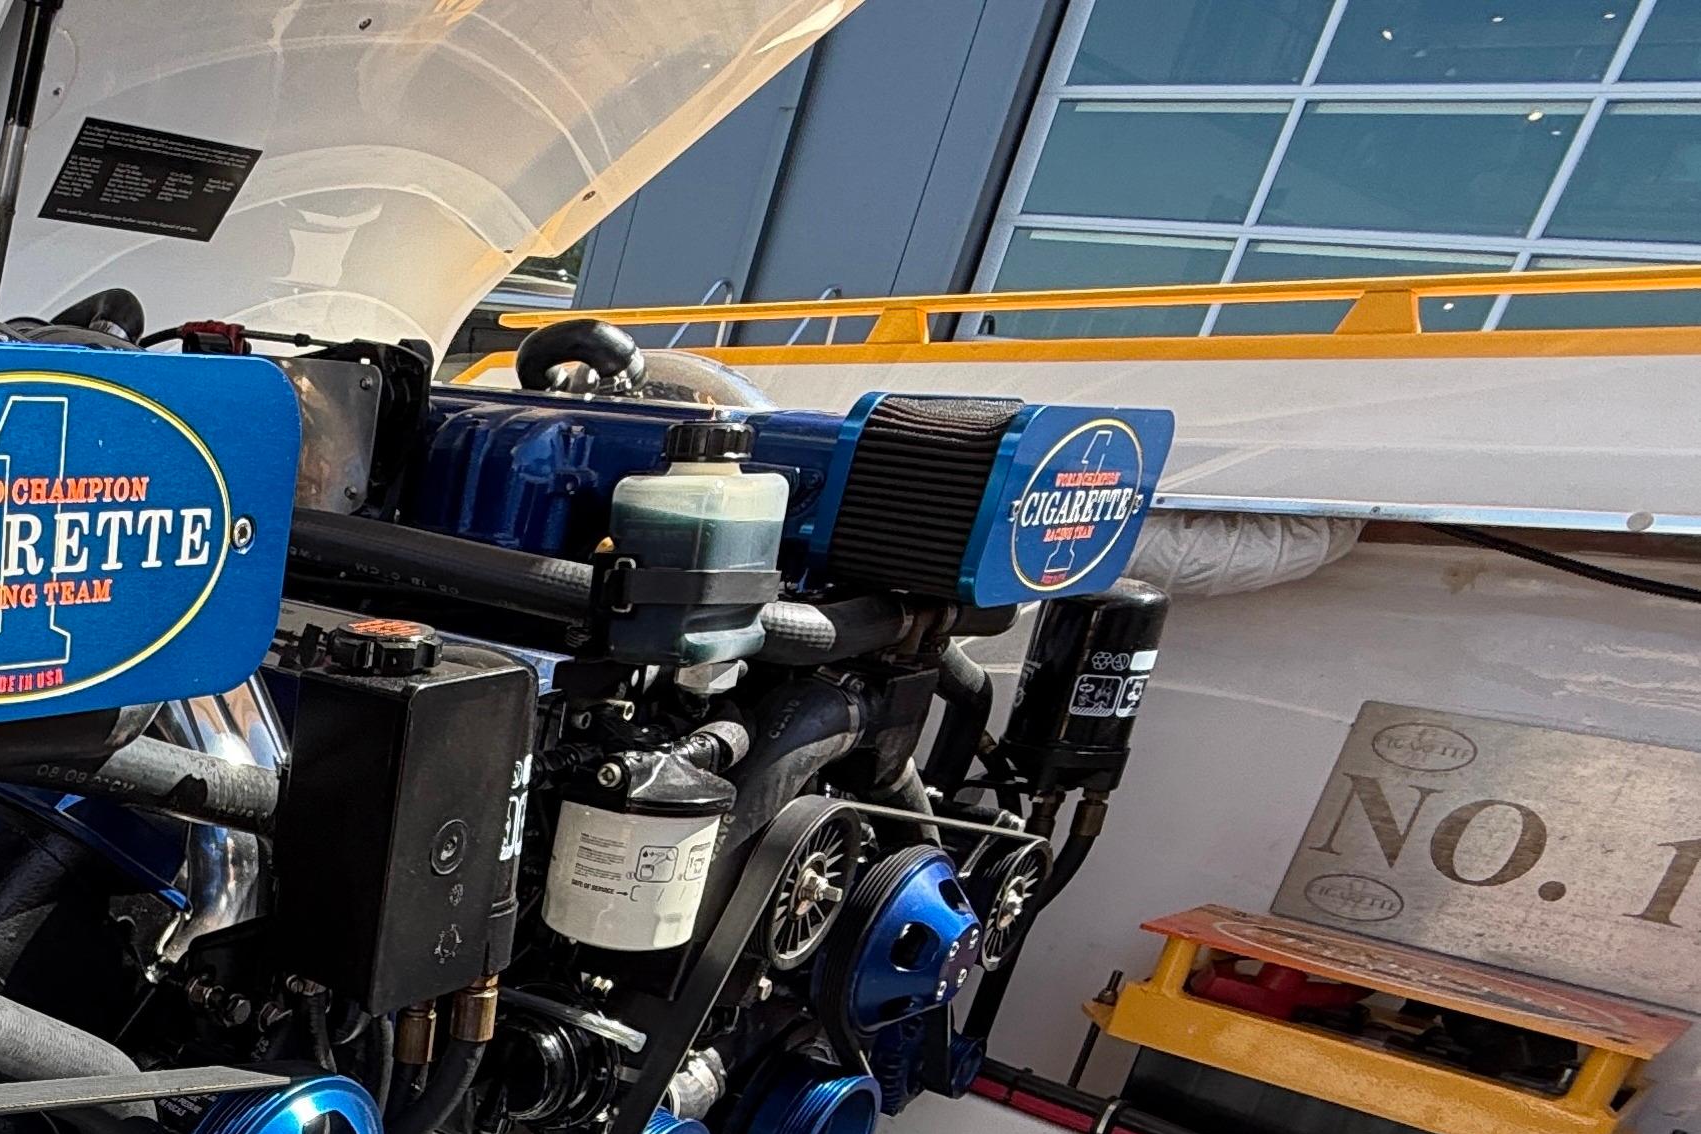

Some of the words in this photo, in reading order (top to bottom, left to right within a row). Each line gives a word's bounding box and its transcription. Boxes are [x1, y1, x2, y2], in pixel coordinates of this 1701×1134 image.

[11, 476, 149, 505] CHAMPION
[1021, 488, 1134, 527] CIGARETTE
[43, 579, 113, 606] TEAM
[18, 672, 32, 692] IN
[36, 668, 64, 688] USA
[1622, 838, 1701, 929] 1
